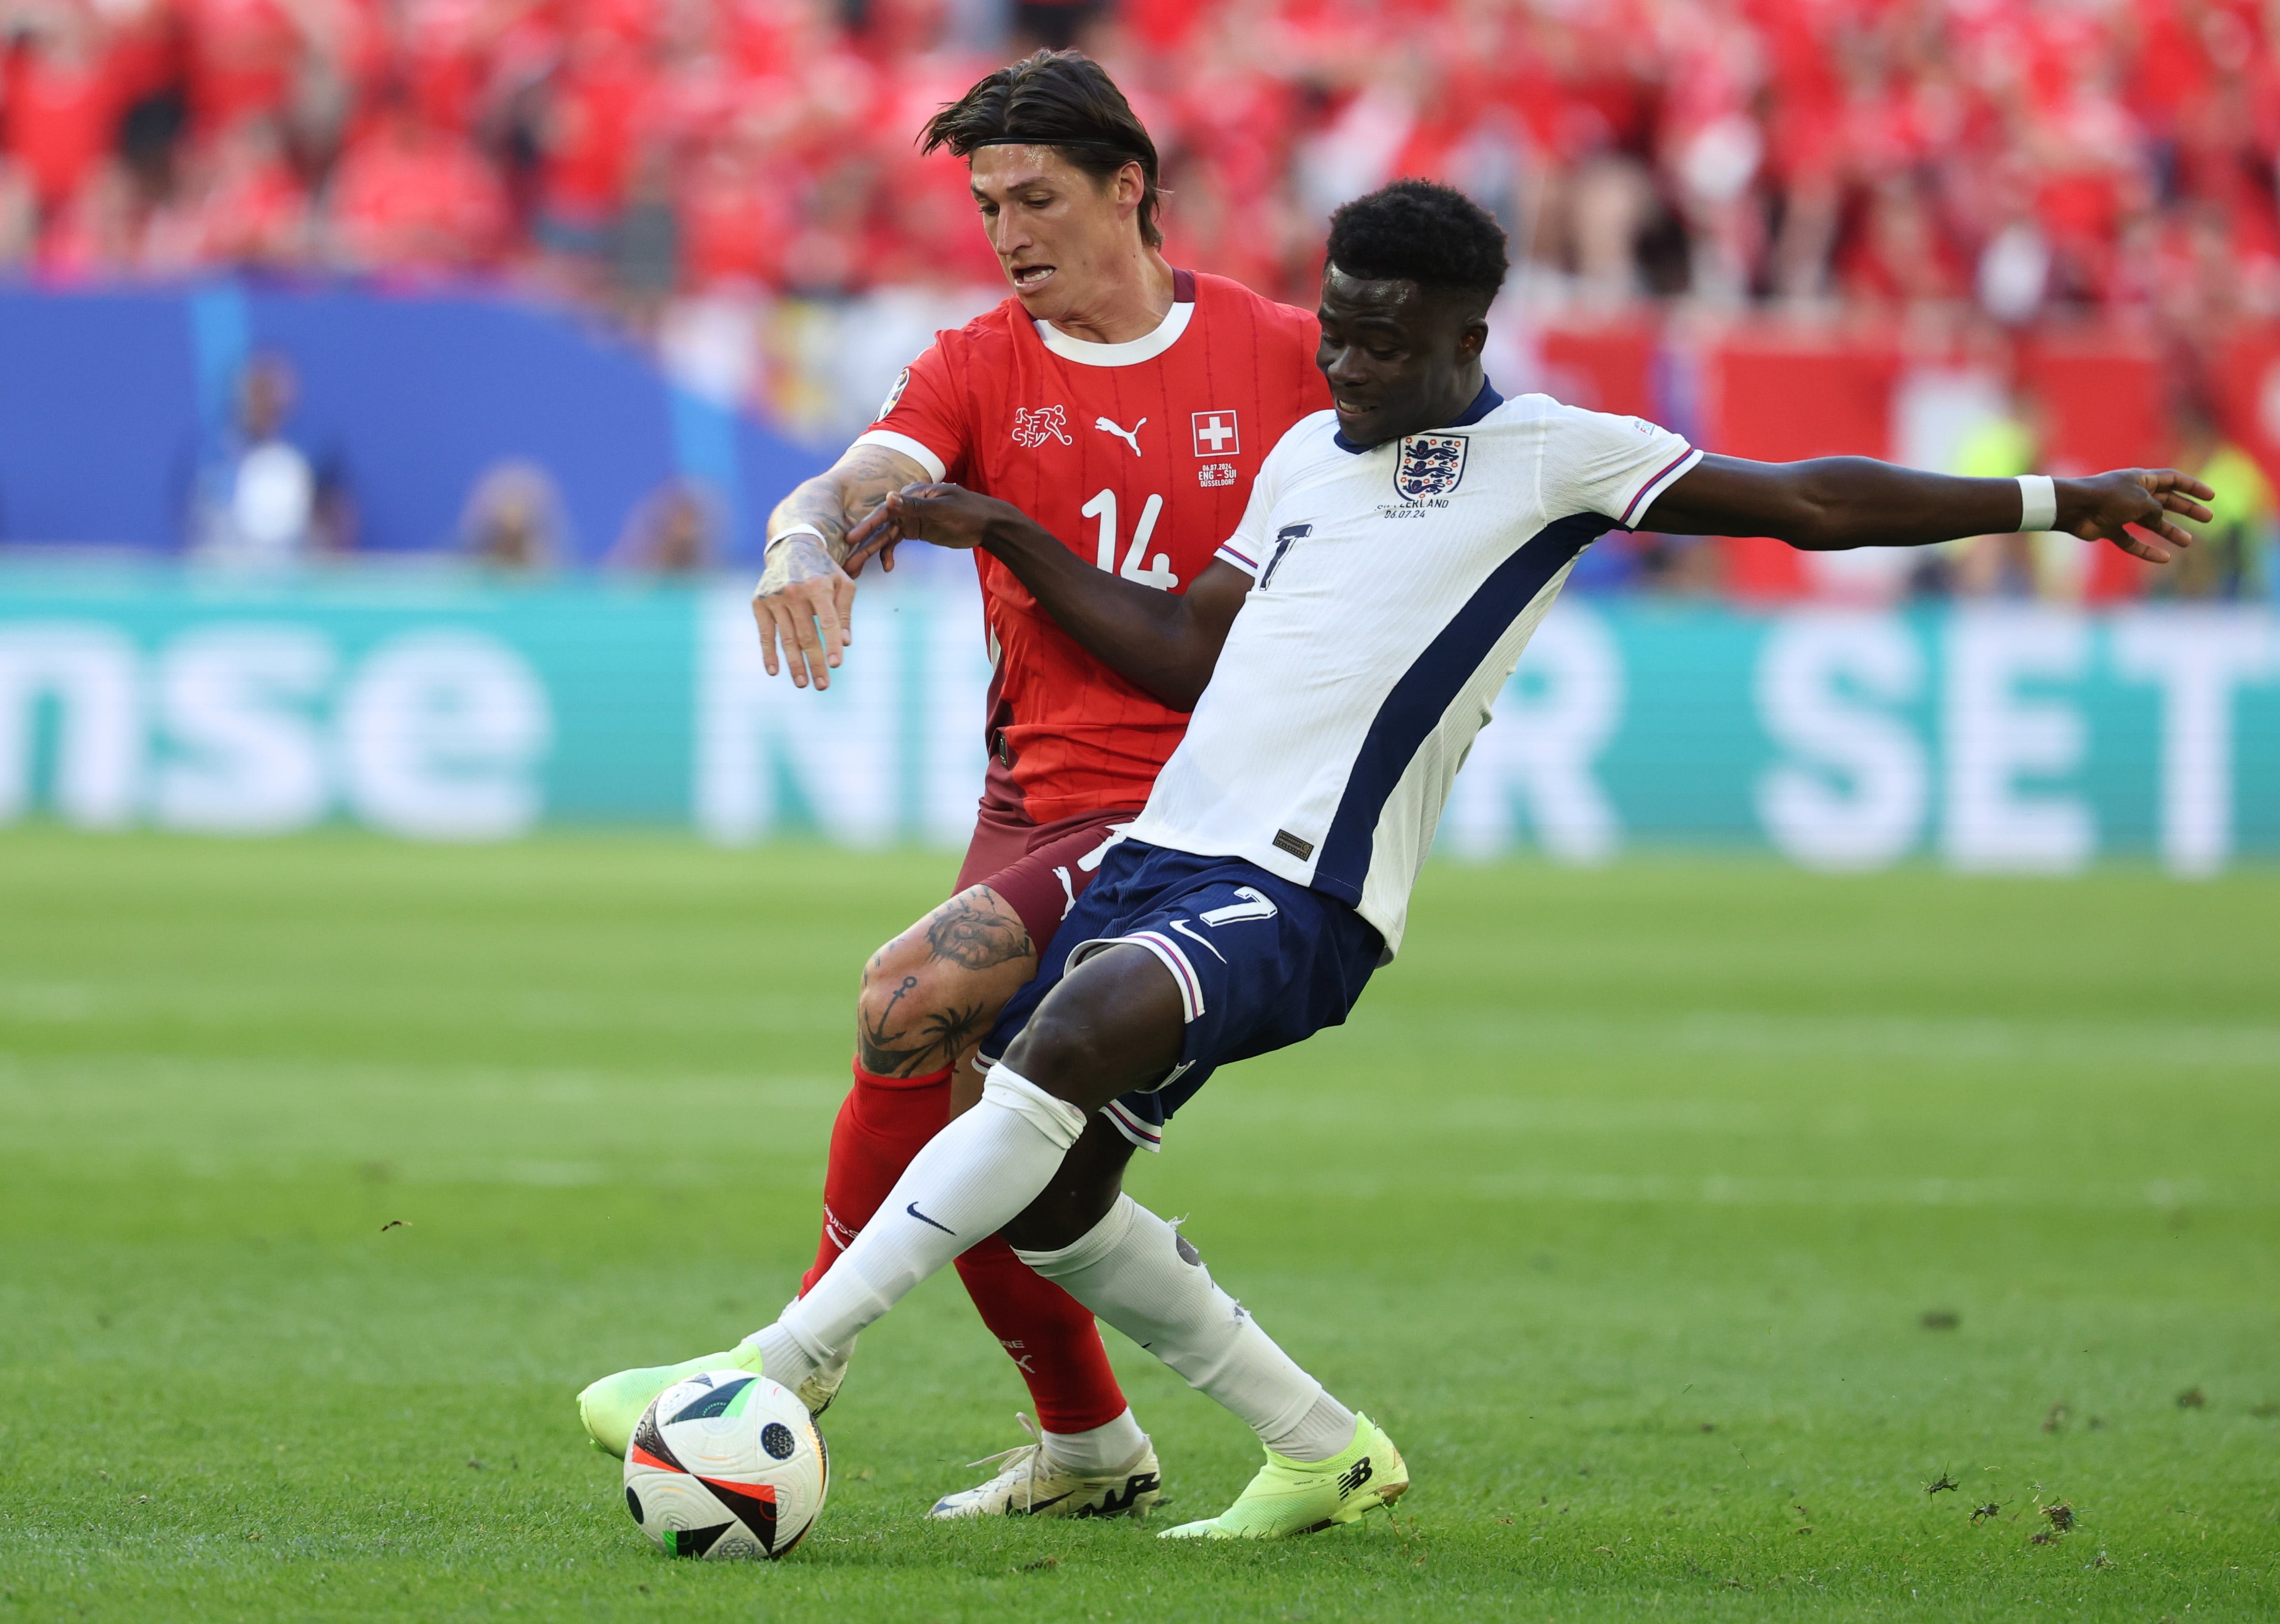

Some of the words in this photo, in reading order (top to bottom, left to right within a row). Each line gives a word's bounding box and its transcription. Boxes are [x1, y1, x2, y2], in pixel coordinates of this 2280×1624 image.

[1199, 472, 1214, 480] ENG
[1224, 470, 1236, 478] SUI
[1201, 479, 1235, 487] DÜSSELDORF
[1384, 509, 1426, 519] 06.07.24
[1081, 488, 1179, 592] 14
[1753, 605, 2280, 878] SET
[1199, 885, 1278, 927] 7
